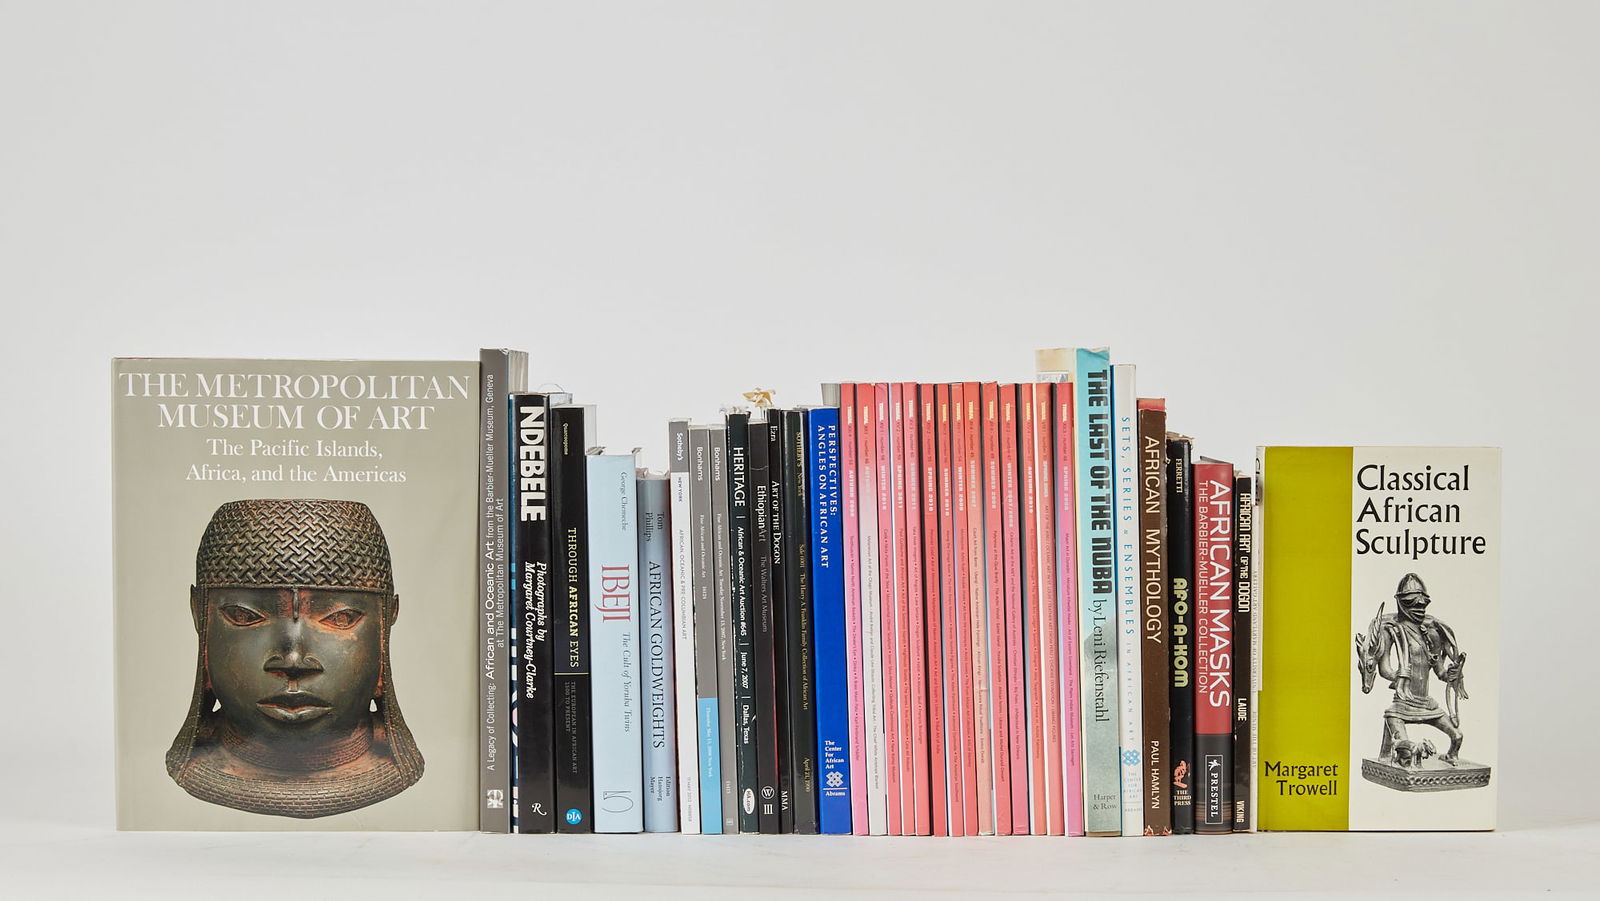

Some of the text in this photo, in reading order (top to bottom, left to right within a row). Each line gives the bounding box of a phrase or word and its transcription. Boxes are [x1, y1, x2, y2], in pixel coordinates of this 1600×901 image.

[119, 372, 471, 400] THE METROPOLITAN
[158, 404, 435, 431] MUSEUM OF ART
[486, 405, 494, 441] Museum,
[207, 439, 382, 460] The Pacific Islands,
[675, 432, 684, 461] Sotheby's
[186, 464, 406, 484] Africa, and the Americas
[486, 444, 494, 502] Barbier-Mueller
[520, 406, 546, 521] NDEBELE
[696, 446, 704, 481] Bonhams
[733, 447, 745, 506] HERITAGE
[828, 425, 837, 516] PERSPECTIVES:
[1175, 458, 1183, 493] FERRETTI
[1357, 464, 1470, 491] Classical
[620, 472, 628, 495] George
[817, 425, 829, 568] ANGLES ON AFRICAN ART
[496, 513, 503, 522] of
[657, 512, 665, 530] Tom
[771, 481, 781, 564] ART OF THE DOGON
[1120, 417, 1134, 635] SETS, SERIES ENSEMBLES
[1357, 497, 1460, 523] African
[496, 525, 504, 561] Museum
[644, 512, 653, 542] Phillips
[1146, 436, 1161, 644] AFRICAN MYTHOLOGY
[485, 541, 494, 558] Art
[1088, 369, 1112, 722] THE LAST OF THE NUBA by Leni Riefenstahl
[1238, 493, 1252, 613] AFRICAN ART OF THE DOGON
[1357, 529, 1486, 560] Sculpture
[485, 563, 494, 609] Oceanic
[738, 557, 746, 583] Oceanic
[760, 569, 768, 592] Walters
[496, 564, 504, 618] Metropolitan
[535, 562, 547, 641] Photographs by
[568, 528, 579, 668] THROUGH AFRICAN EYES
[594, 564, 631, 623] IBEJI
[798, 584, 806, 600] Harry
[1199, 481, 1208, 693] THE BARBIER-MUELLER COLLECTION
[1209, 480, 1231, 707] AFRICAN MASKS
[485, 613, 494, 635] and
[739, 595, 747, 620] Auction
[496, 621, 504, 636] The
[497, 639, 504, 648] at
[523, 562, 536, 698] Margaret Courtney-Clarke
[740, 622, 748, 636] #645
[1173, 578, 1189, 687] AFO-A-KOM
[485, 638, 494, 679] African
[648, 561, 665, 748] AFRICAN GOLDWEIGHTS
[740, 652, 748, 666] June
[621, 632, 632, 733] The Cult of Yoruba Twins
[487, 683, 496, 724] Collecting:
[742, 705, 750, 725] Dallas,
[1238, 698, 1247, 721] LAUDE
[487, 736, 496, 763] Legacy
[1151, 740, 1160, 809] PAUL HAMLYN
[1265, 761, 1338, 778] Margaret
[1093, 794, 1116, 802] Harper
[1210, 773, 1218, 817] PRESTEL
[1276, 780, 1338, 796] Trowell
[1236, 801, 1245, 822] VIKING
